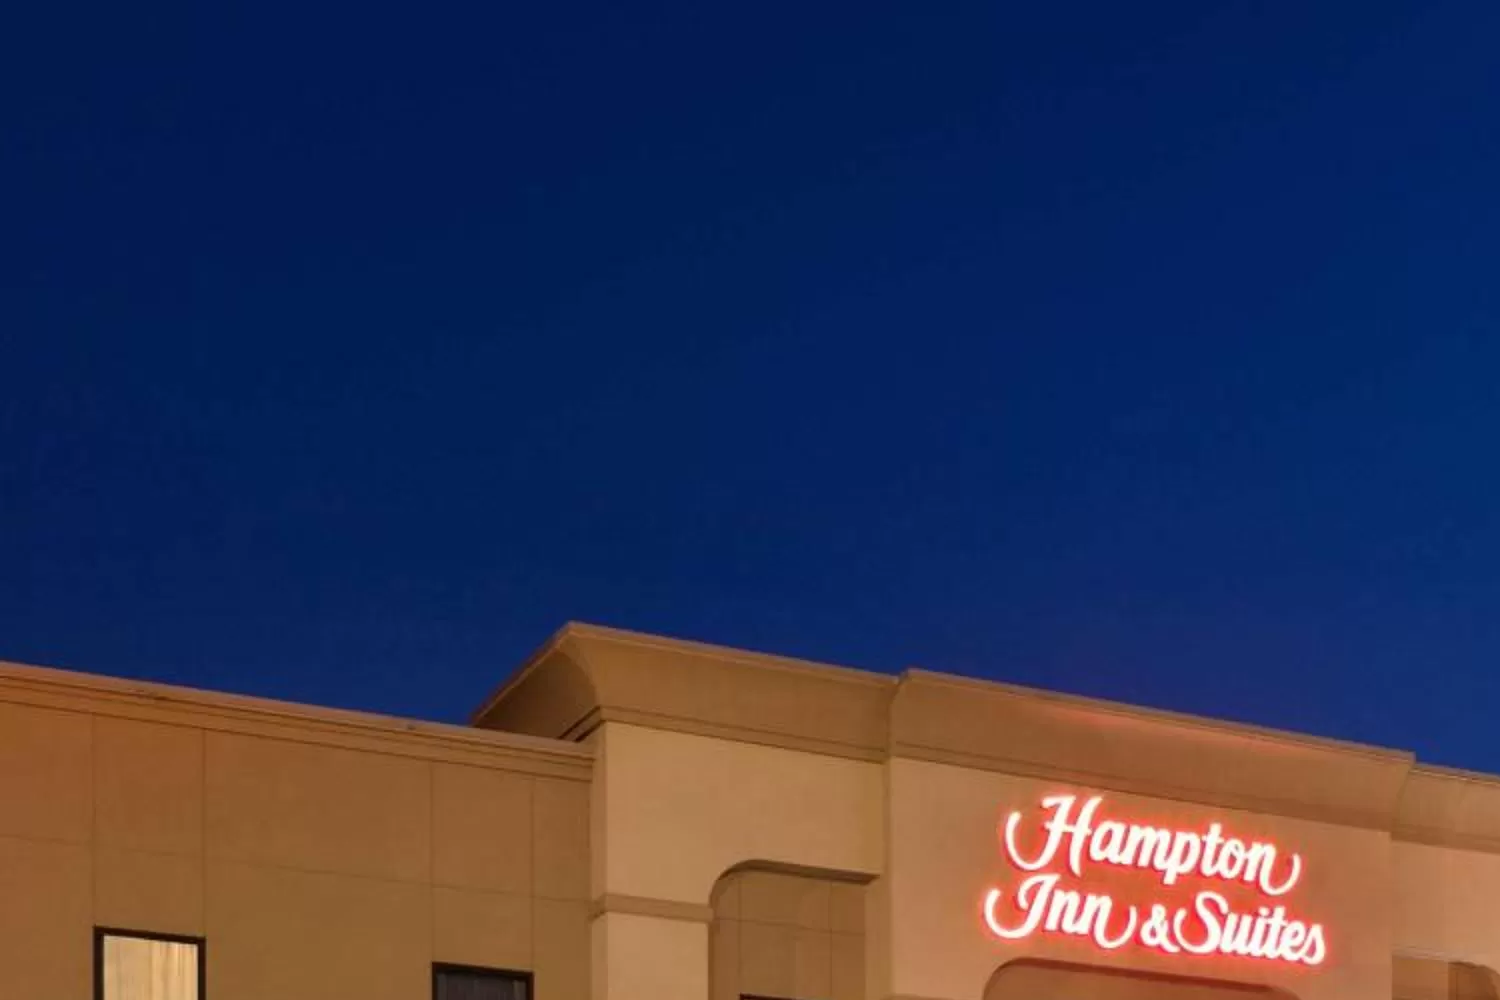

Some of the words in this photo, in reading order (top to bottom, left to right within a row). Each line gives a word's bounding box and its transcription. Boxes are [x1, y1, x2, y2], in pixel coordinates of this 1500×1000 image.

[1005, 795, 1301, 896] Hampton
[984, 874, 1137, 949] Inn
[1140, 905, 1182, 953] &
[1173, 891, 1326, 965] Suites
